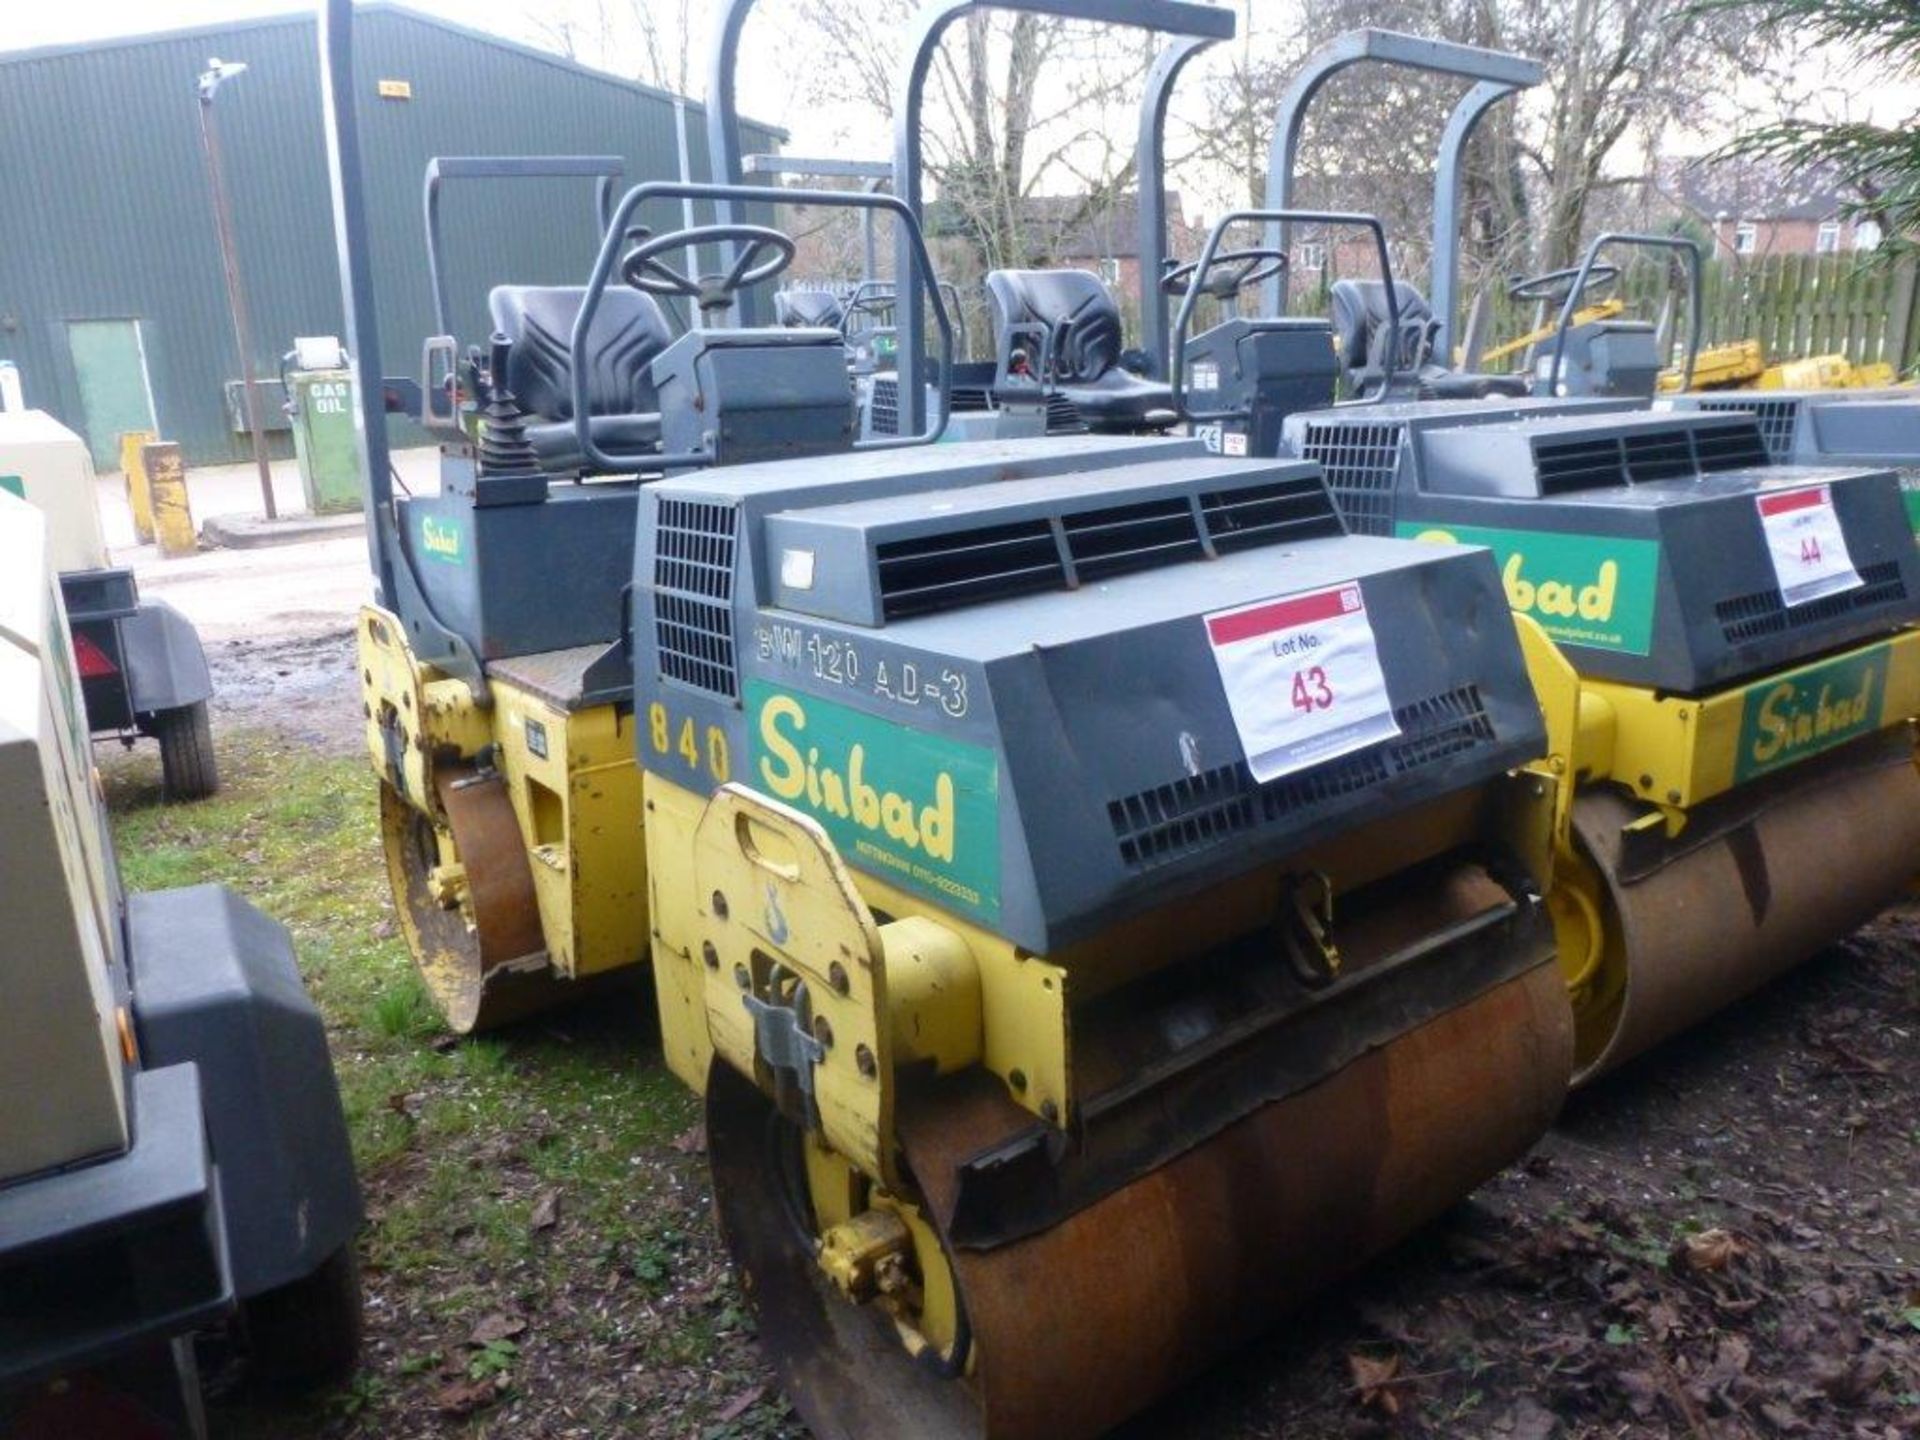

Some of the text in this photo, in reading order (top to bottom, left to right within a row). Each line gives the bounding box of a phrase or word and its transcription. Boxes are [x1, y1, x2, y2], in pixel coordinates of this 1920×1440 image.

[311, 383, 346, 397] GAS
[317, 398, 347, 413] OIL
[1801, 536, 1822, 564] 44
[807, 633, 861, 685] 120
[1273, 634, 1322, 657] Lot No.
[1292, 666, 1332, 713] 43
[1754, 665, 1873, 761] Sinbad
[760, 695, 954, 863] Sinbad
